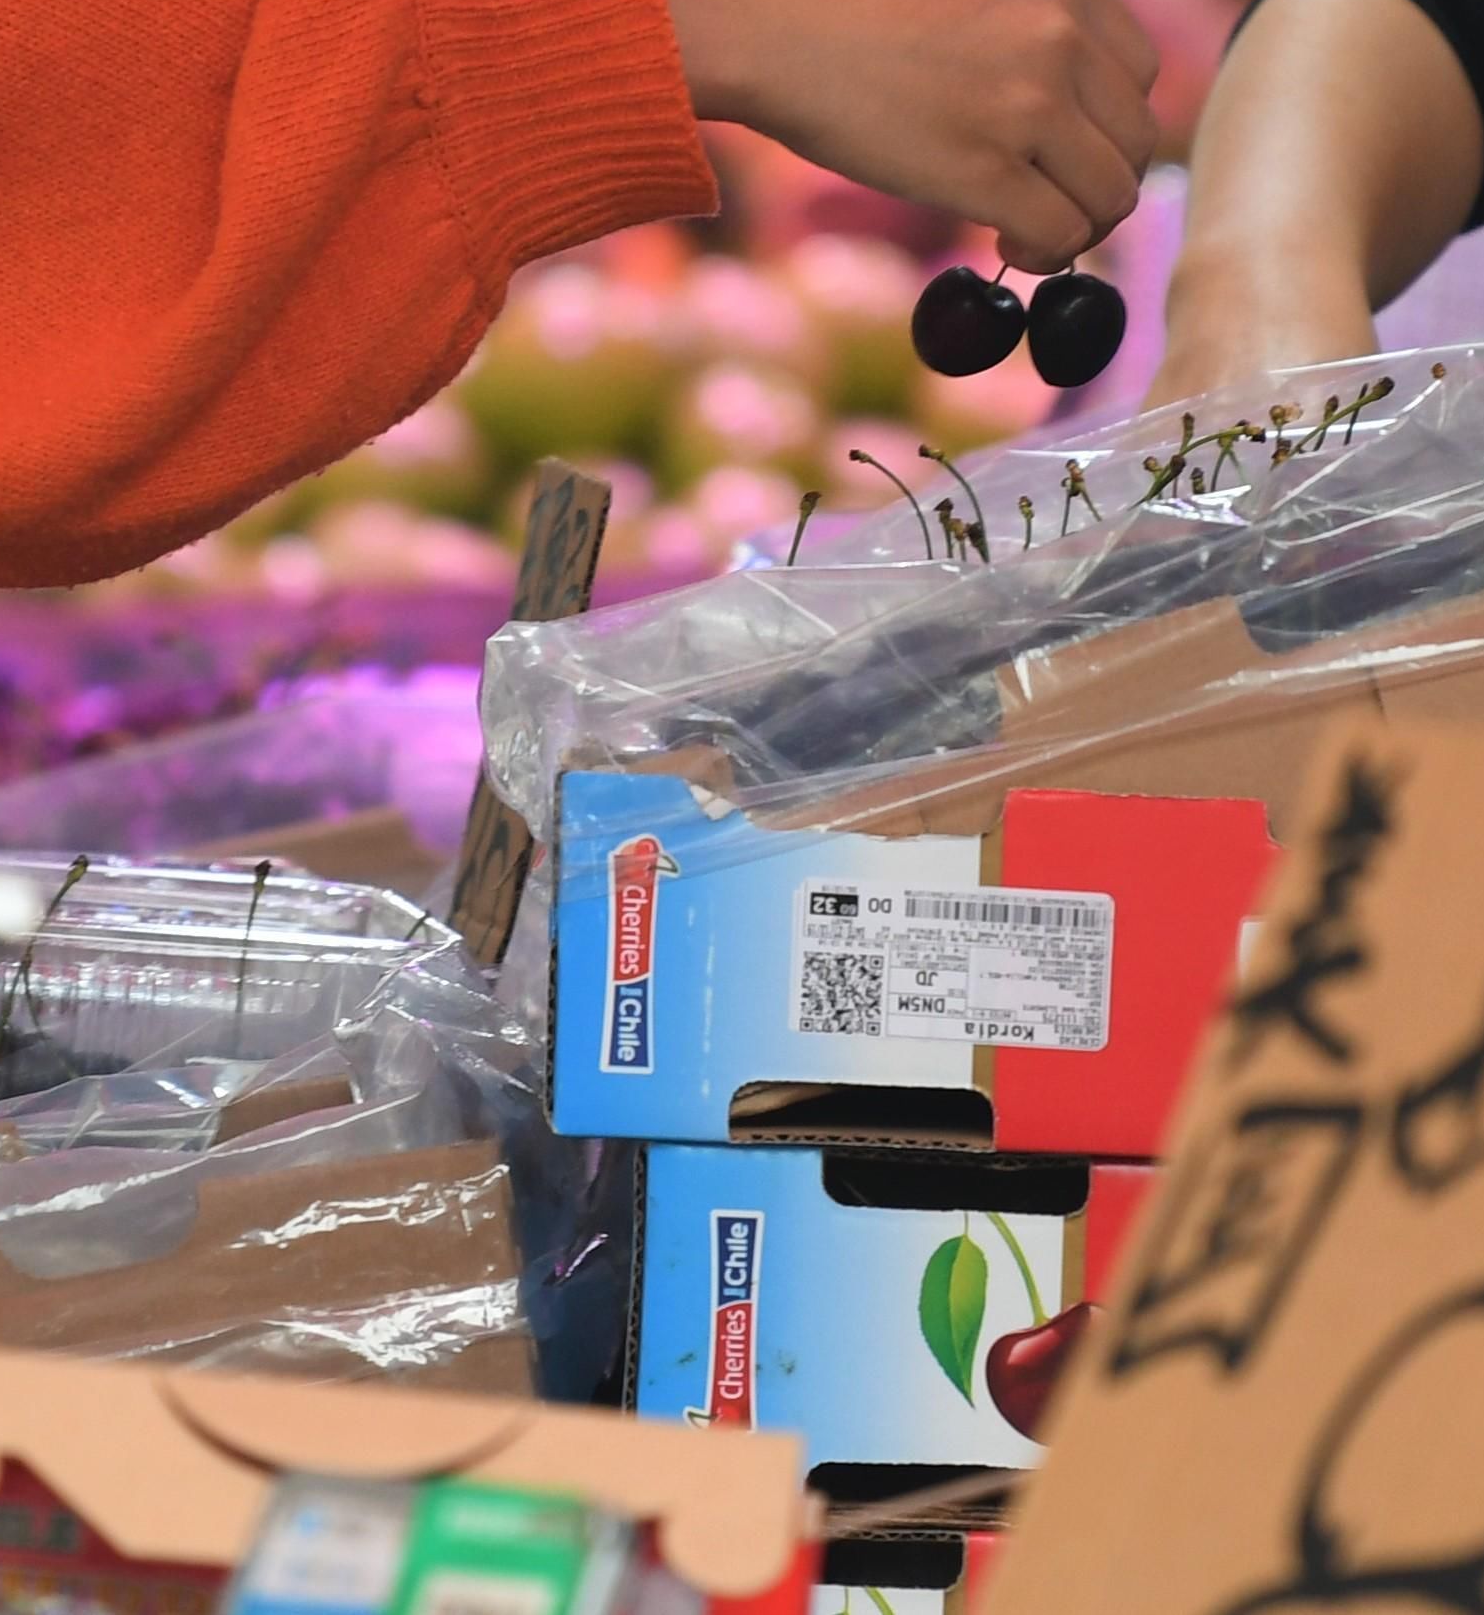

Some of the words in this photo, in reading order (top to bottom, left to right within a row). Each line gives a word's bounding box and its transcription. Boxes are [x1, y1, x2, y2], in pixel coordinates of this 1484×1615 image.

[812, 896, 838, 915] 32
[620, 884, 648, 975] Cherries
[915, 971, 939, 987] JD
[898, 996, 946, 1014] DN5M
[617, 998, 643, 1063] Chile
[964, 1022, 1035, 1042] Kordia
[724, 1222, 749, 1286] Chile
[717, 1309, 747, 1400] Cherries
